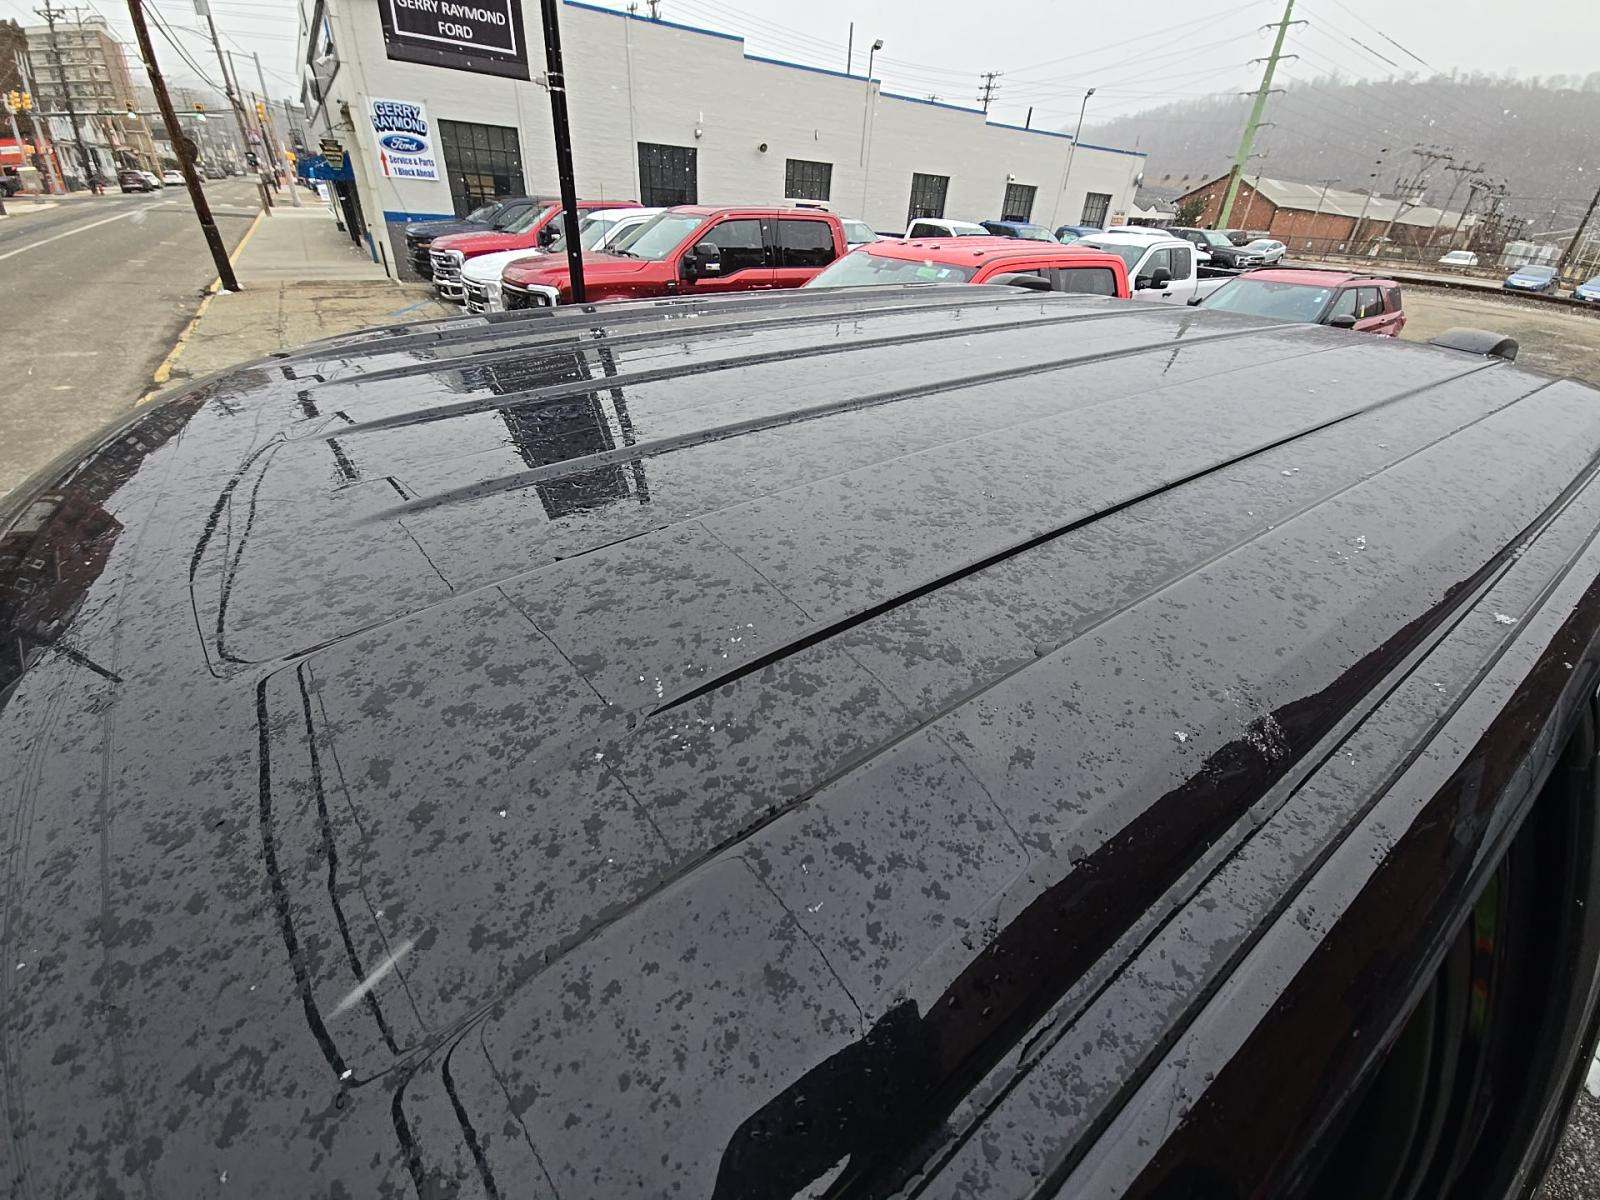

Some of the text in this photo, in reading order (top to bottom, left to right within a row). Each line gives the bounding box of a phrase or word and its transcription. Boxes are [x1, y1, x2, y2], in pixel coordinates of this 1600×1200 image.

[441, 2, 506, 25] RAYMOND
[438, 21, 473, 39] FORD
[371, 101, 428, 136] GERRY RAYMOND
[390, 137, 418, 151] Ford
[388, 155, 412, 165] Service
[419, 157, 434, 167] Parts
[416, 168, 435, 178] Ahead
